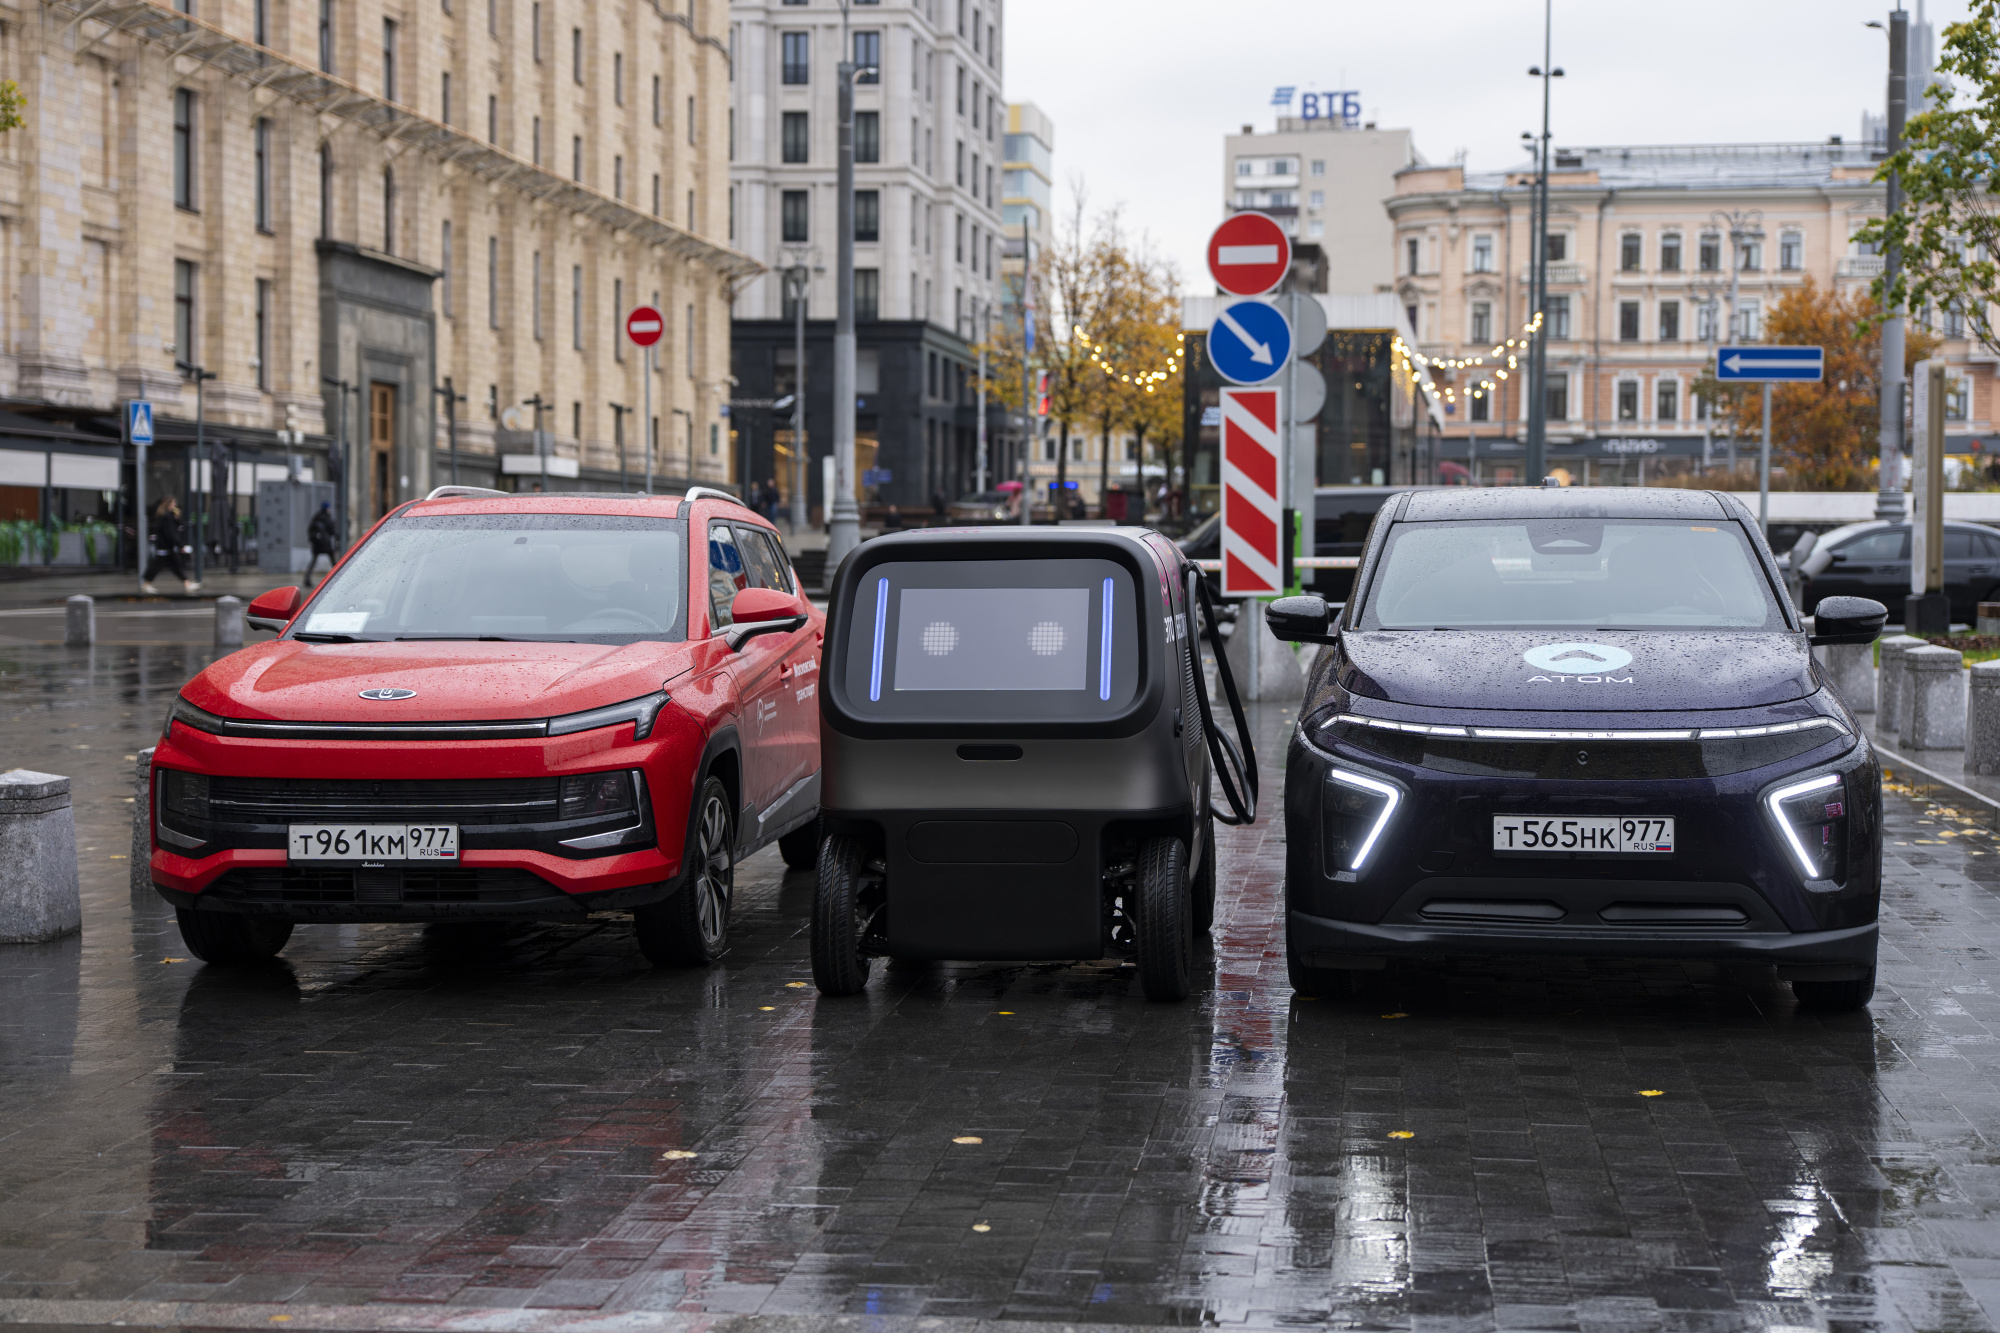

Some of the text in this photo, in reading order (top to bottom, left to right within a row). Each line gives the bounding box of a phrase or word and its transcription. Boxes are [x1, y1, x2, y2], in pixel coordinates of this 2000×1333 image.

[1302, 91, 1361, 119] ВТБ
[1526, 675, 1634, 684] ATOM
[410, 828, 450, 848] 977
[1622, 820, 1666, 842] 977
[420, 848, 440, 857] RUS
[1633, 842, 1655, 851] RUS
